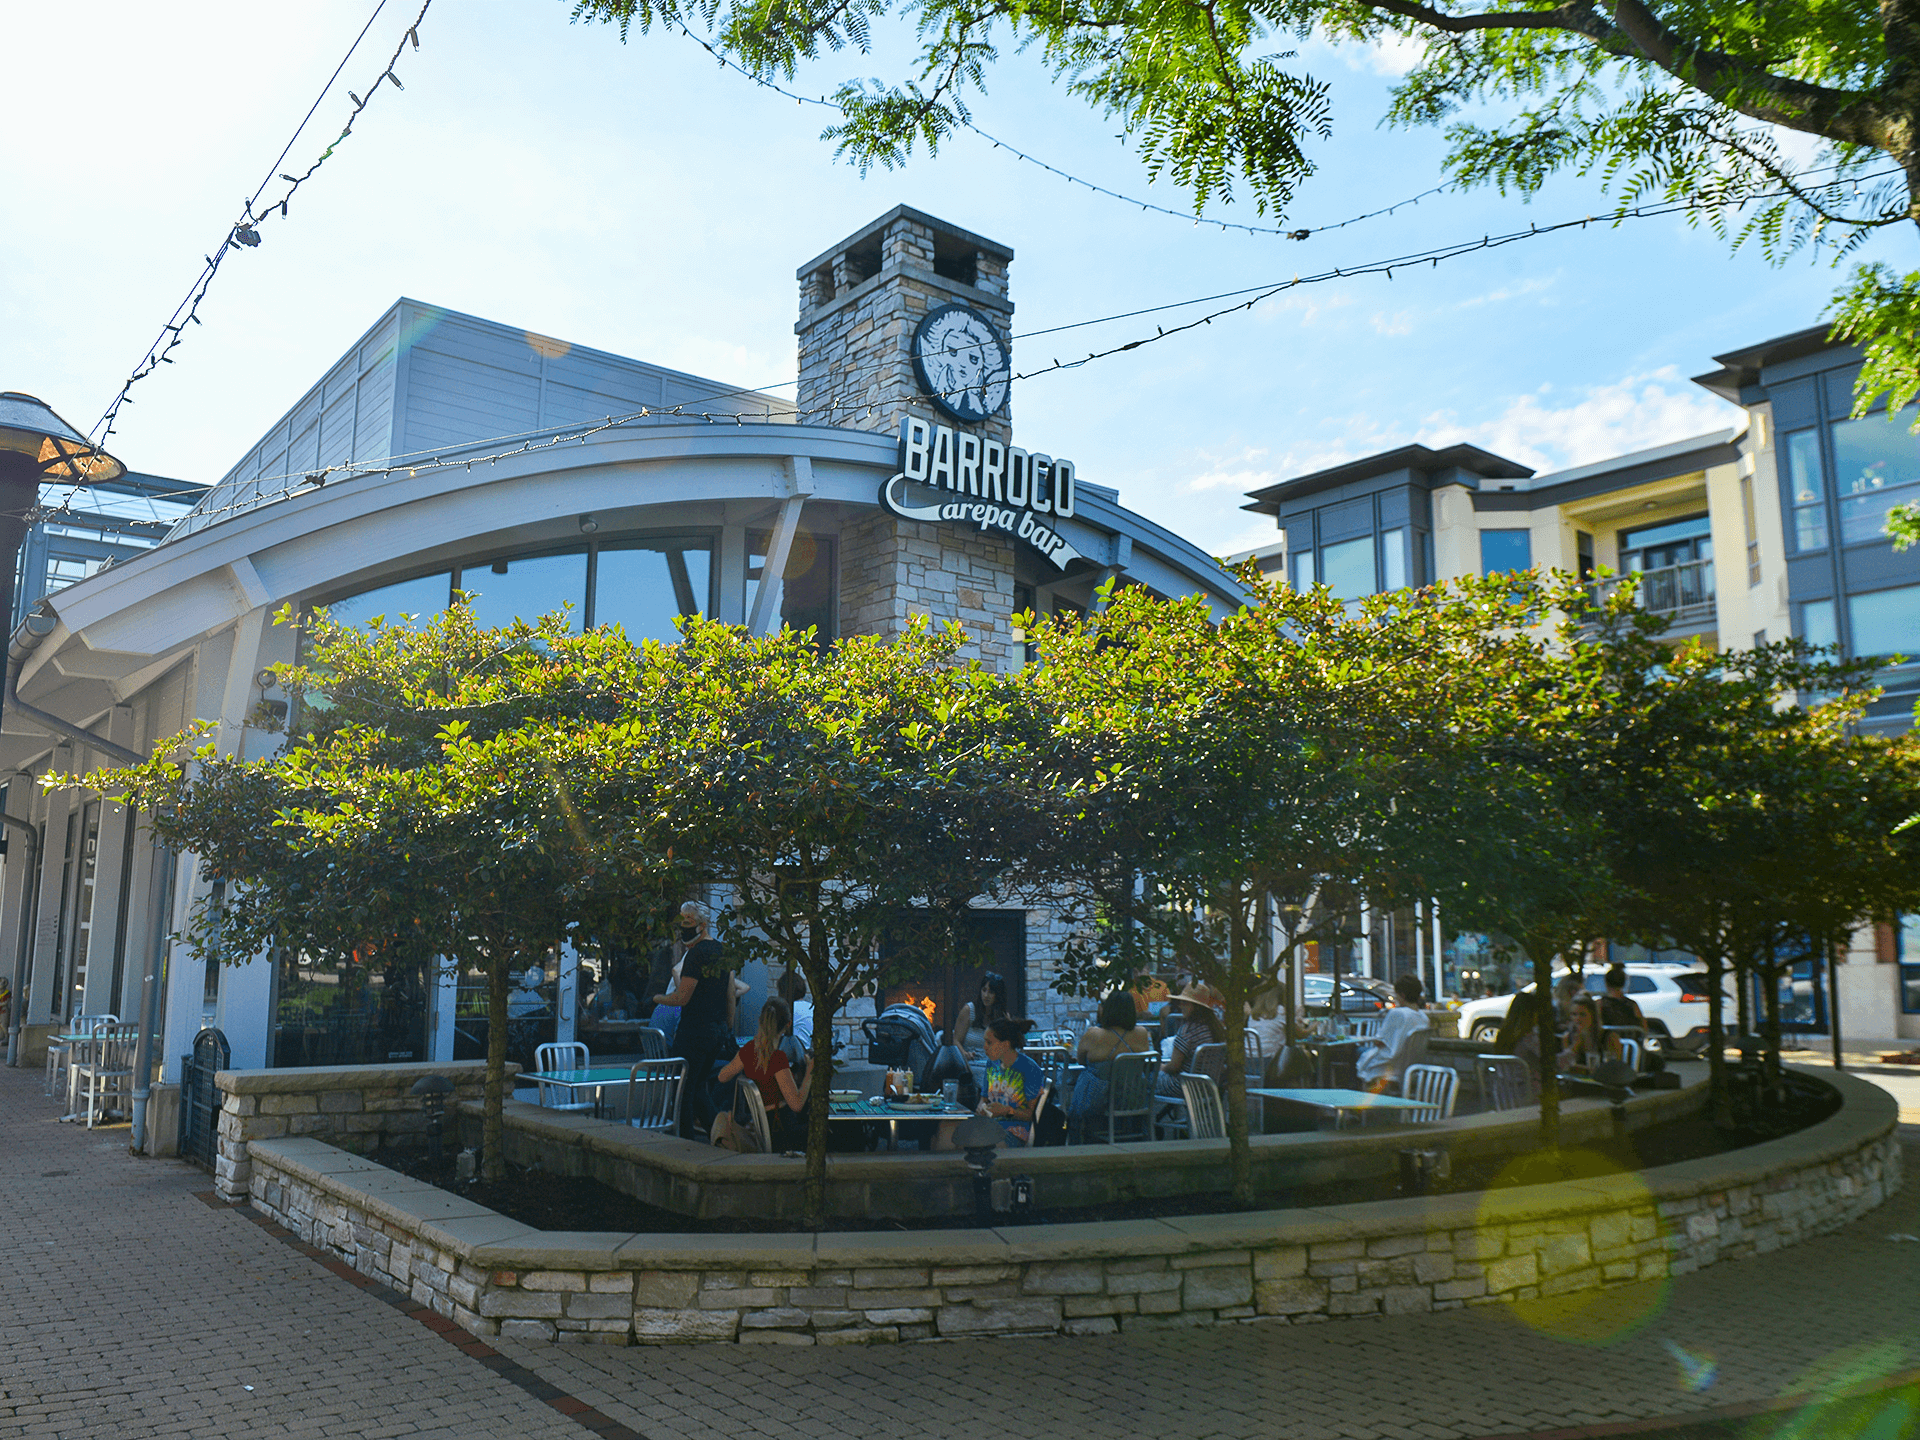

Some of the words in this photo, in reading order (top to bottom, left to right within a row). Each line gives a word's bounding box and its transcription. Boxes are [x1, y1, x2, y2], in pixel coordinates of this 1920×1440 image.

[903, 415, 1075, 518] BARROCO
[942, 502, 1016, 531] arepa
[1018, 511, 1063, 555] bar
